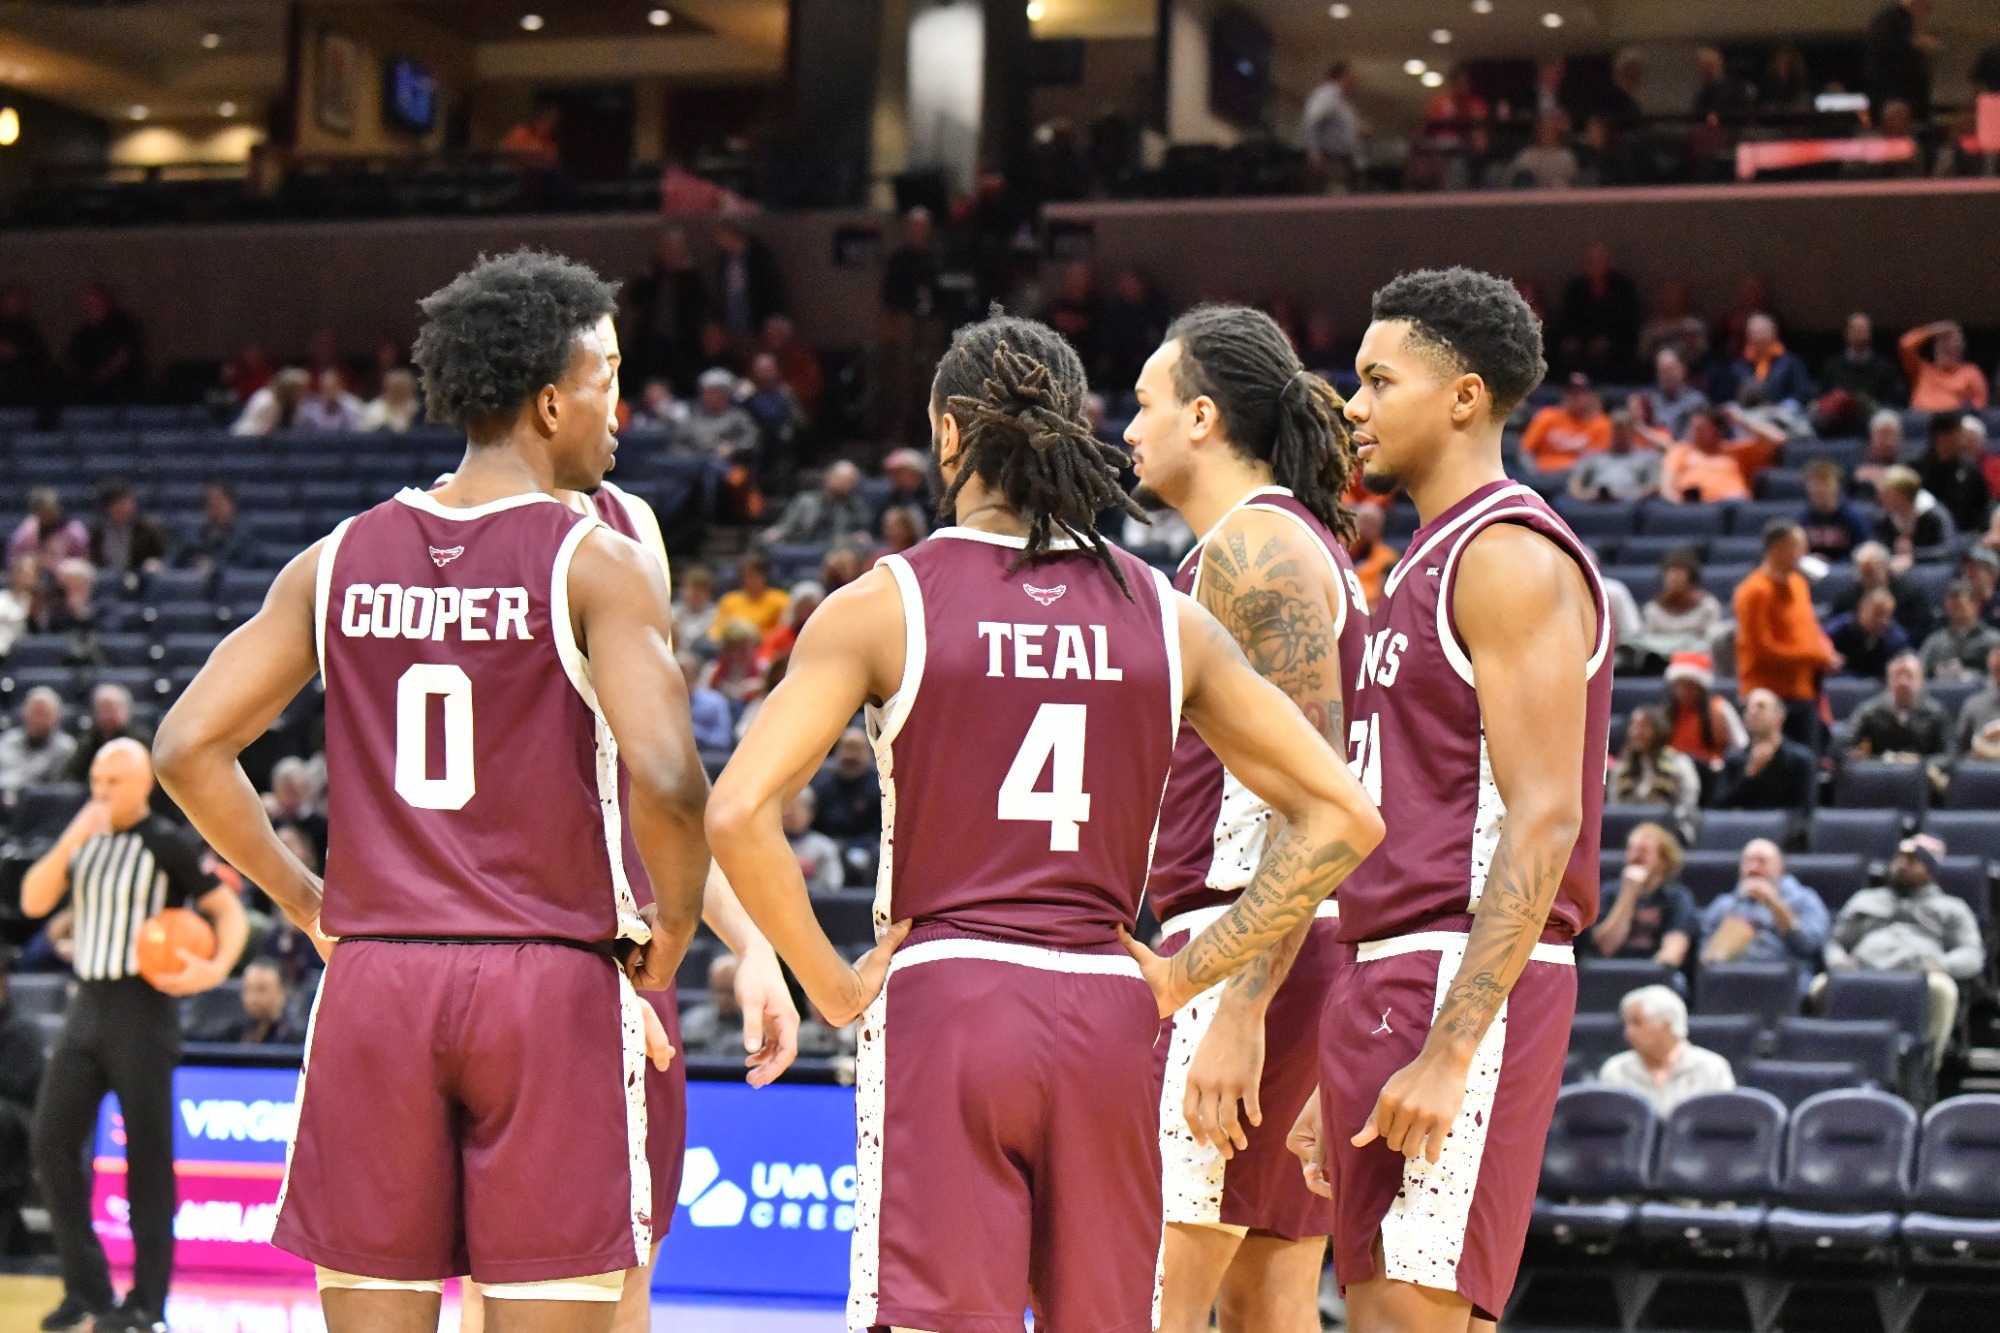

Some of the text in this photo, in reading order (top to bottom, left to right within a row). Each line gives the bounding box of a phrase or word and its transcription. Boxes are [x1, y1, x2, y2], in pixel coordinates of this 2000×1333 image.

[342, 583, 534, 641] COOPER
[978, 621, 1122, 681] TEAL
[394, 663, 476, 810] 0
[997, 703, 1090, 852] 4
